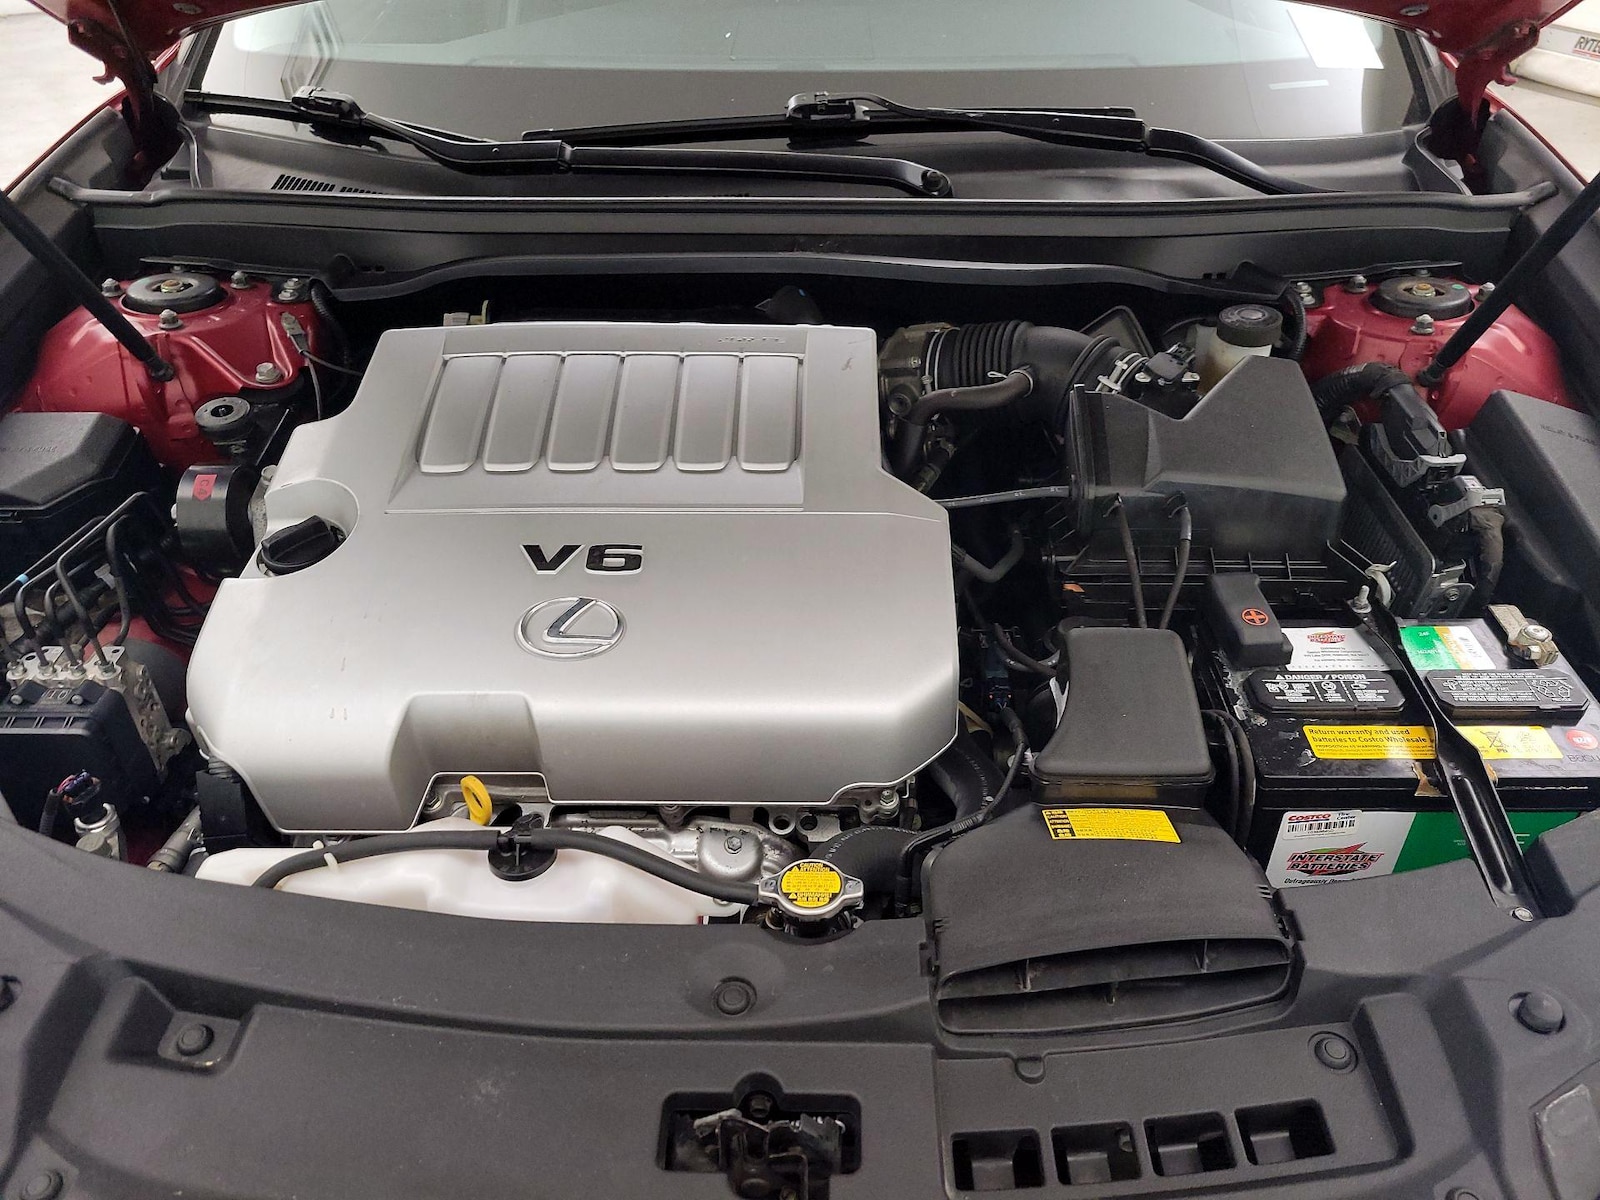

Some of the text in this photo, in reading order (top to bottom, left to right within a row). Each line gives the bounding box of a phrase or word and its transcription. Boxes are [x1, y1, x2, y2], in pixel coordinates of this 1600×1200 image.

[1574, 36, 1600, 54] RYTE
[521, 543, 644, 576] V6
[1337, 728, 1373, 736] warranty
[1288, 813, 1332, 821] COSTCO
[1290, 853, 1380, 862] INTERSTATE
[1289, 862, 1370, 870] BATTERIES
